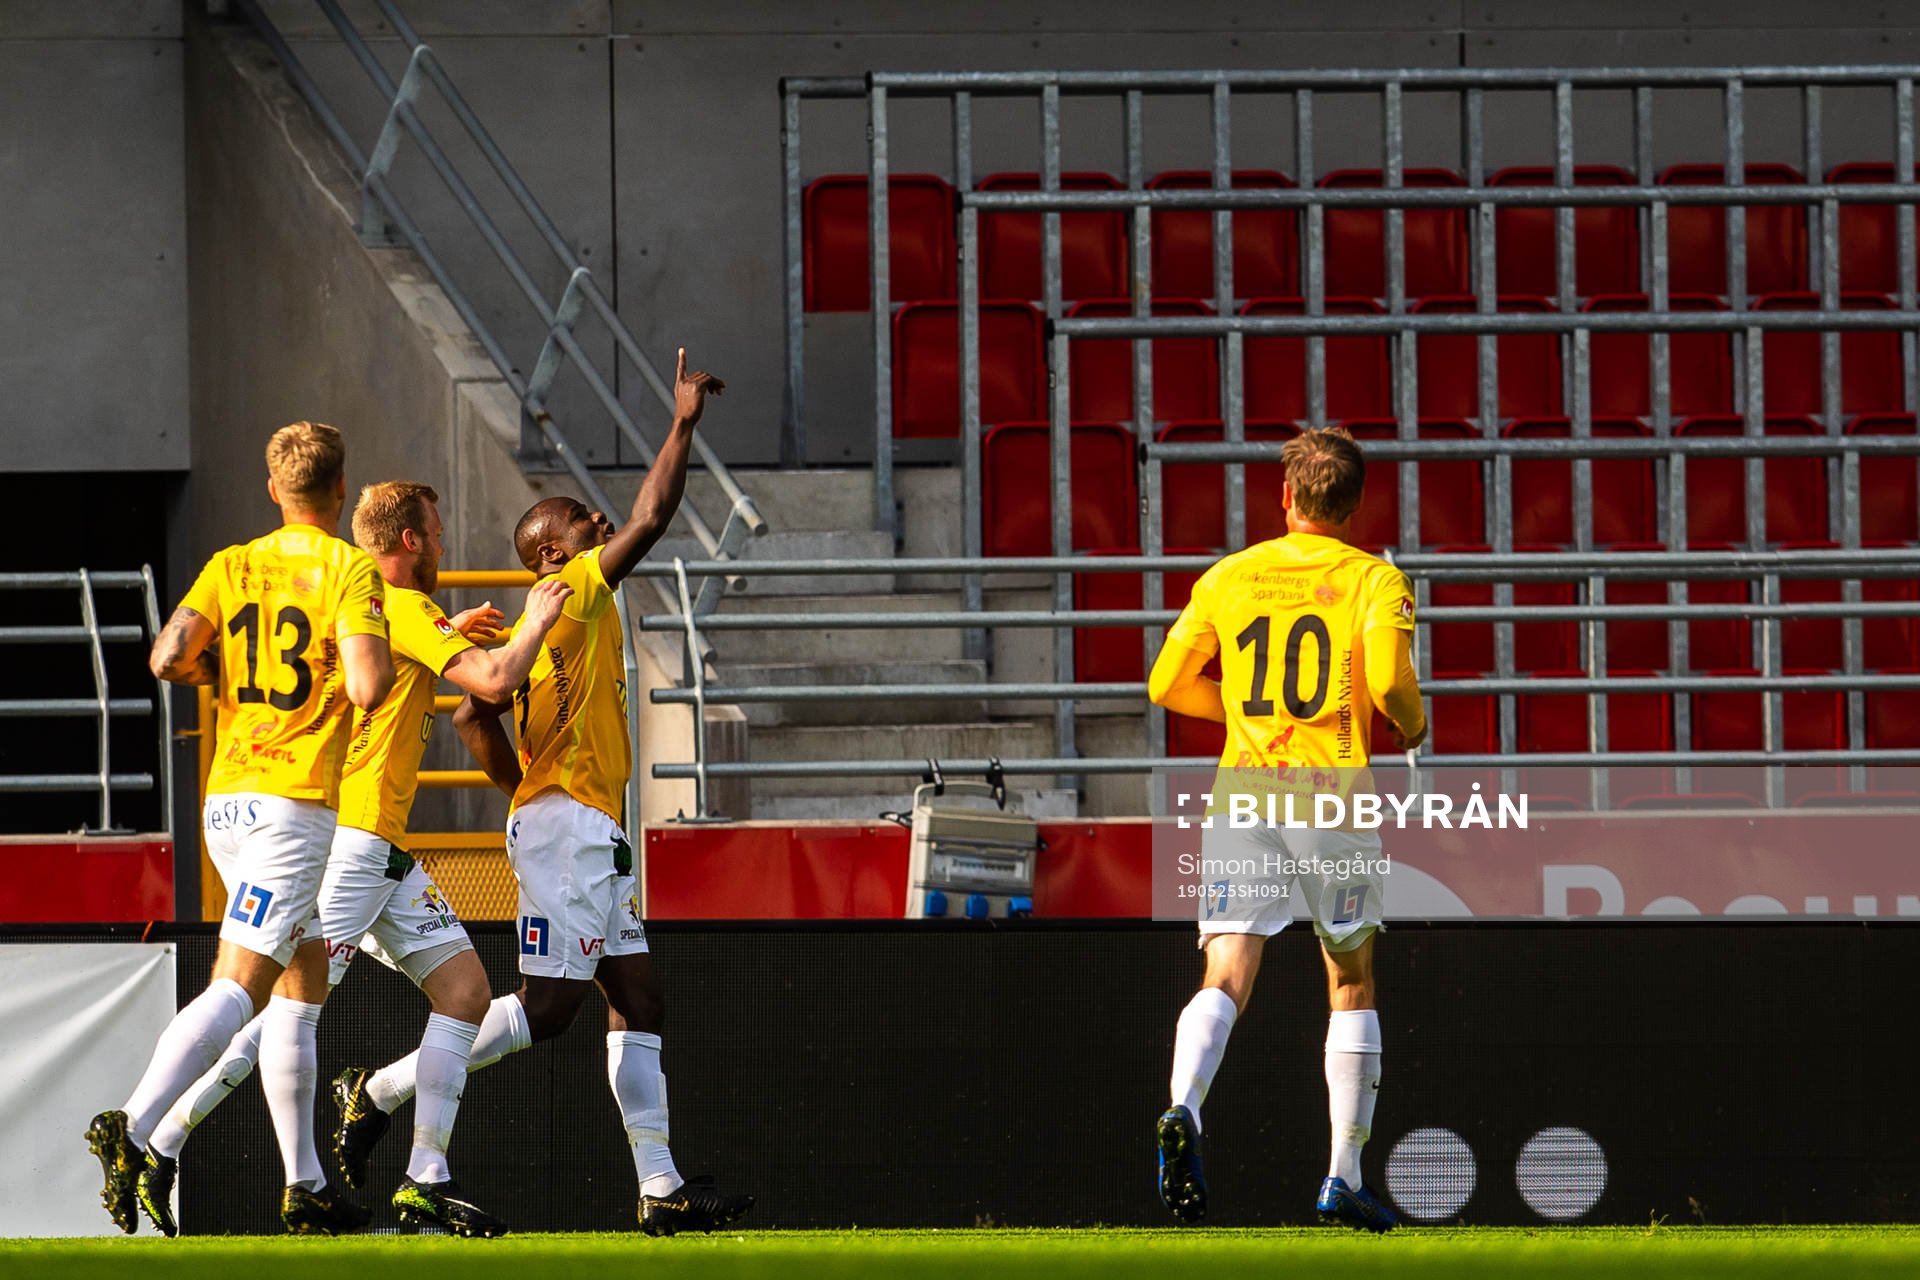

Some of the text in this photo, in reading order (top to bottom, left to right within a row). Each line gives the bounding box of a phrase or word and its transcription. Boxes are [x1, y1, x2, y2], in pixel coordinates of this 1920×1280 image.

[1239, 571, 1311, 589] Falkenbergs
[227, 602, 313, 712] 13
[1235, 613, 1332, 720] 10
[1336, 649, 1353, 760] Hallands Nyheter
[416, 918, 442, 934] SPECIAL
